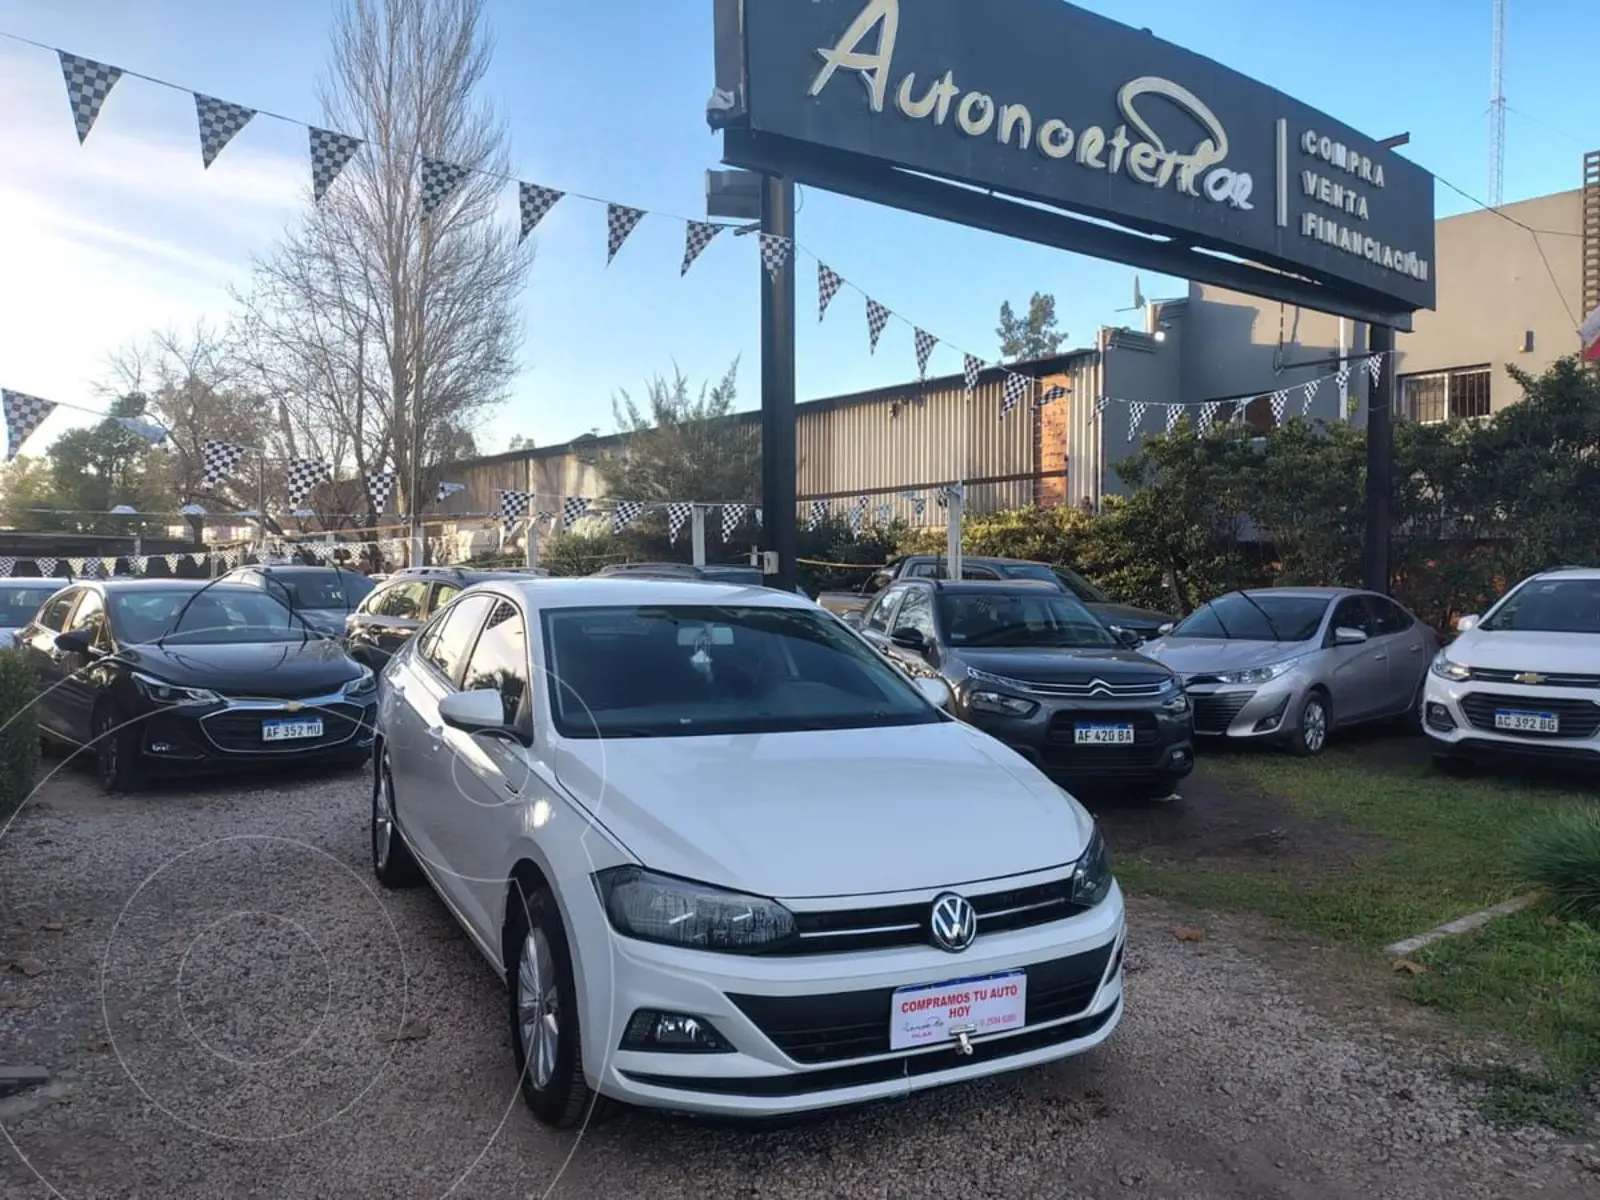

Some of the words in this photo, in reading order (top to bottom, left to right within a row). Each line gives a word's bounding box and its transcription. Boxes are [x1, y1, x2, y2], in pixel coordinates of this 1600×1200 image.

[1301, 129, 1385, 188] COMPRA
[1301, 170, 1369, 220] VENTA
[1301, 211, 1428, 281] FINANCIACIÓN
[283, 725, 305, 737] 352
[1497, 715, 1511, 726] AC
[1514, 716, 1537, 729] 392
[1078, 730, 1092, 741] AF
[1095, 730, 1115, 741] 420
[1118, 730, 1132, 741] BA
[901, 991, 970, 1013] COMPRAMOS
[973, 989, 987, 1002] TU
[990, 984, 1018, 998] AUTO
[949, 1005, 971, 1018] HOY
